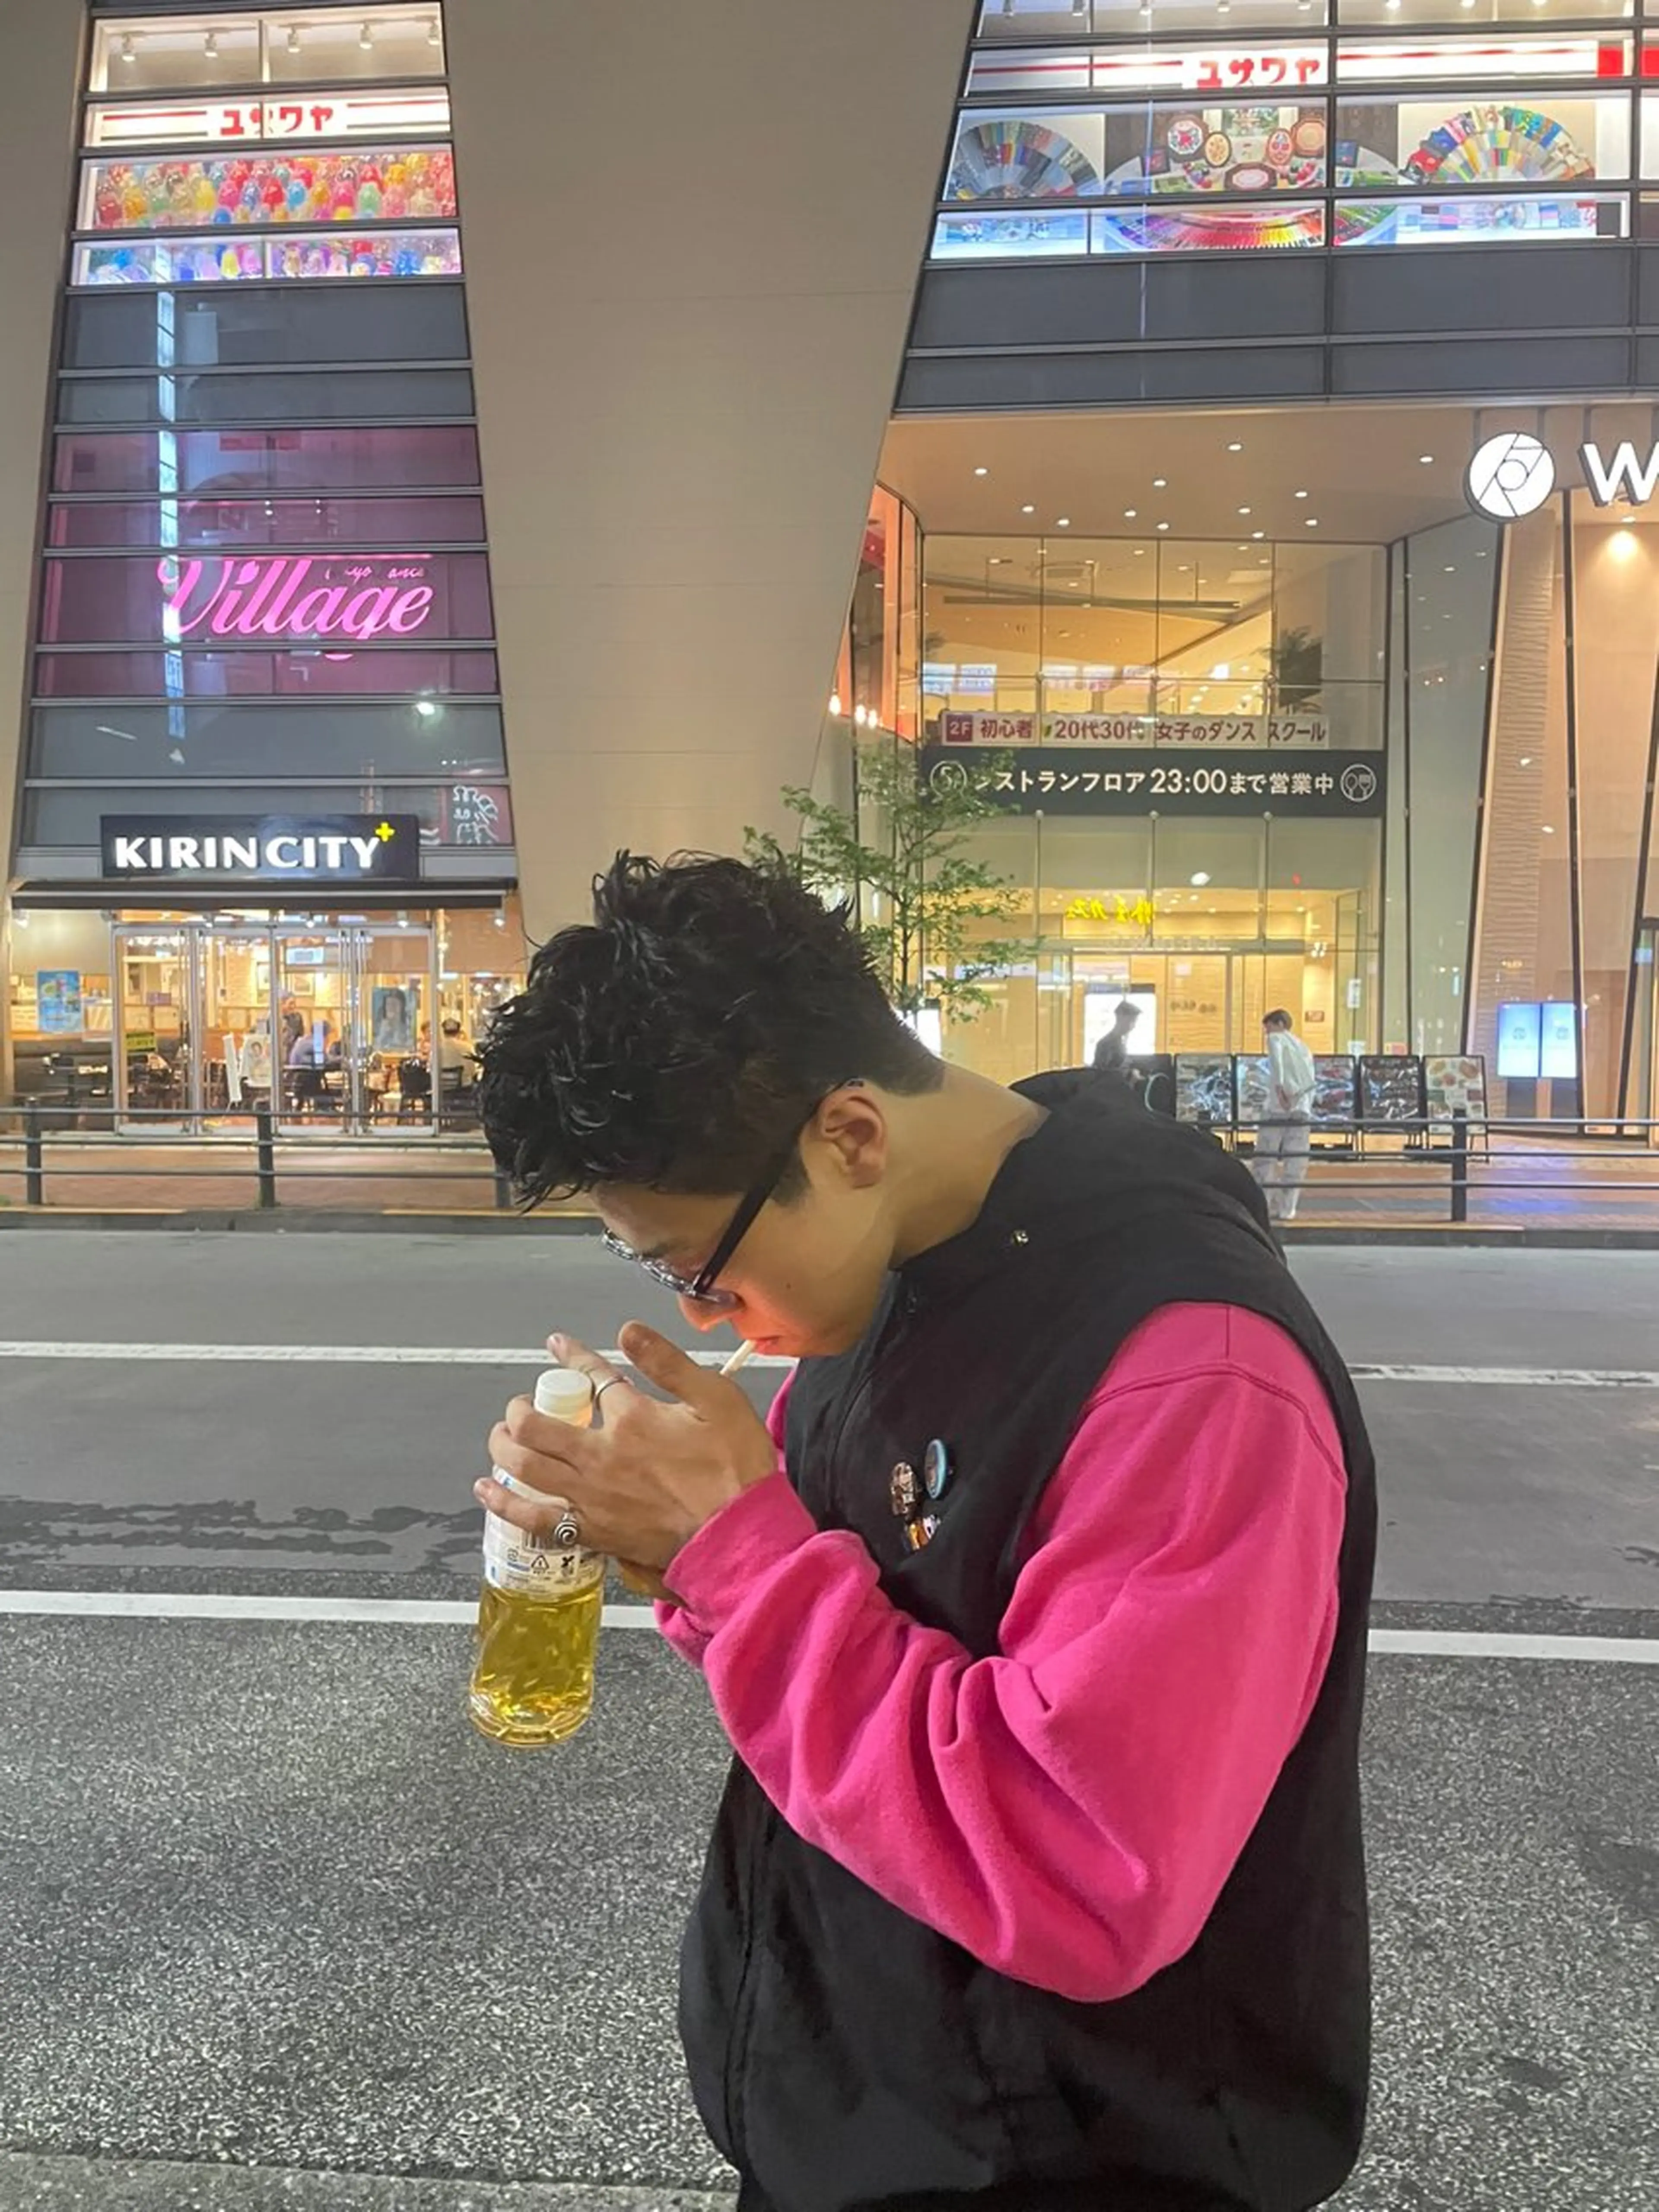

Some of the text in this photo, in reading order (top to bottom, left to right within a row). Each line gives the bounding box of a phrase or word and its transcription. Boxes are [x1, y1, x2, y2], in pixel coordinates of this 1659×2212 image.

[157, 555, 432, 660] Village
[950, 721, 971, 737] 2F
[980, 718, 1033, 739] 初心者
